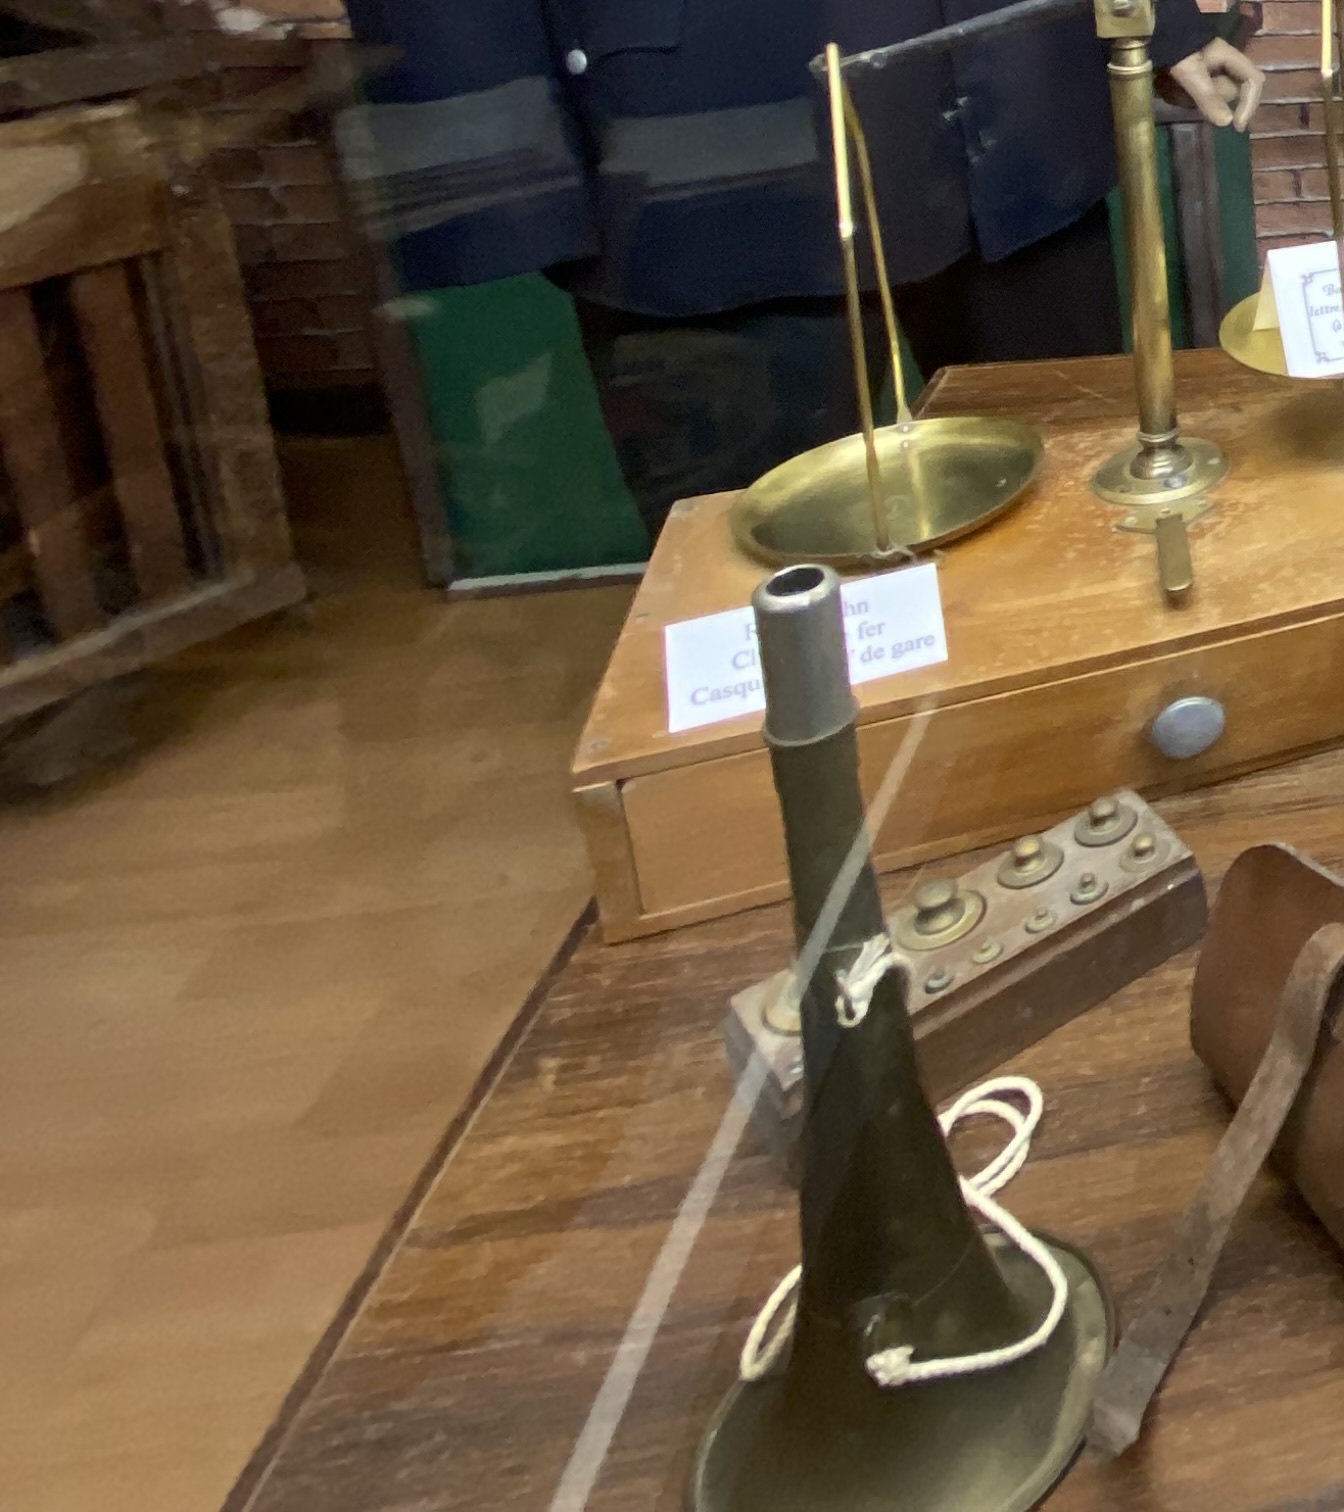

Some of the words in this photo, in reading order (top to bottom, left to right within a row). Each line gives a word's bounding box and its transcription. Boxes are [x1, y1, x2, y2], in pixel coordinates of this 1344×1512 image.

[858, 619, 886, 641] fer
[860, 645, 884, 663] de
[891, 634, 936, 662] gare
